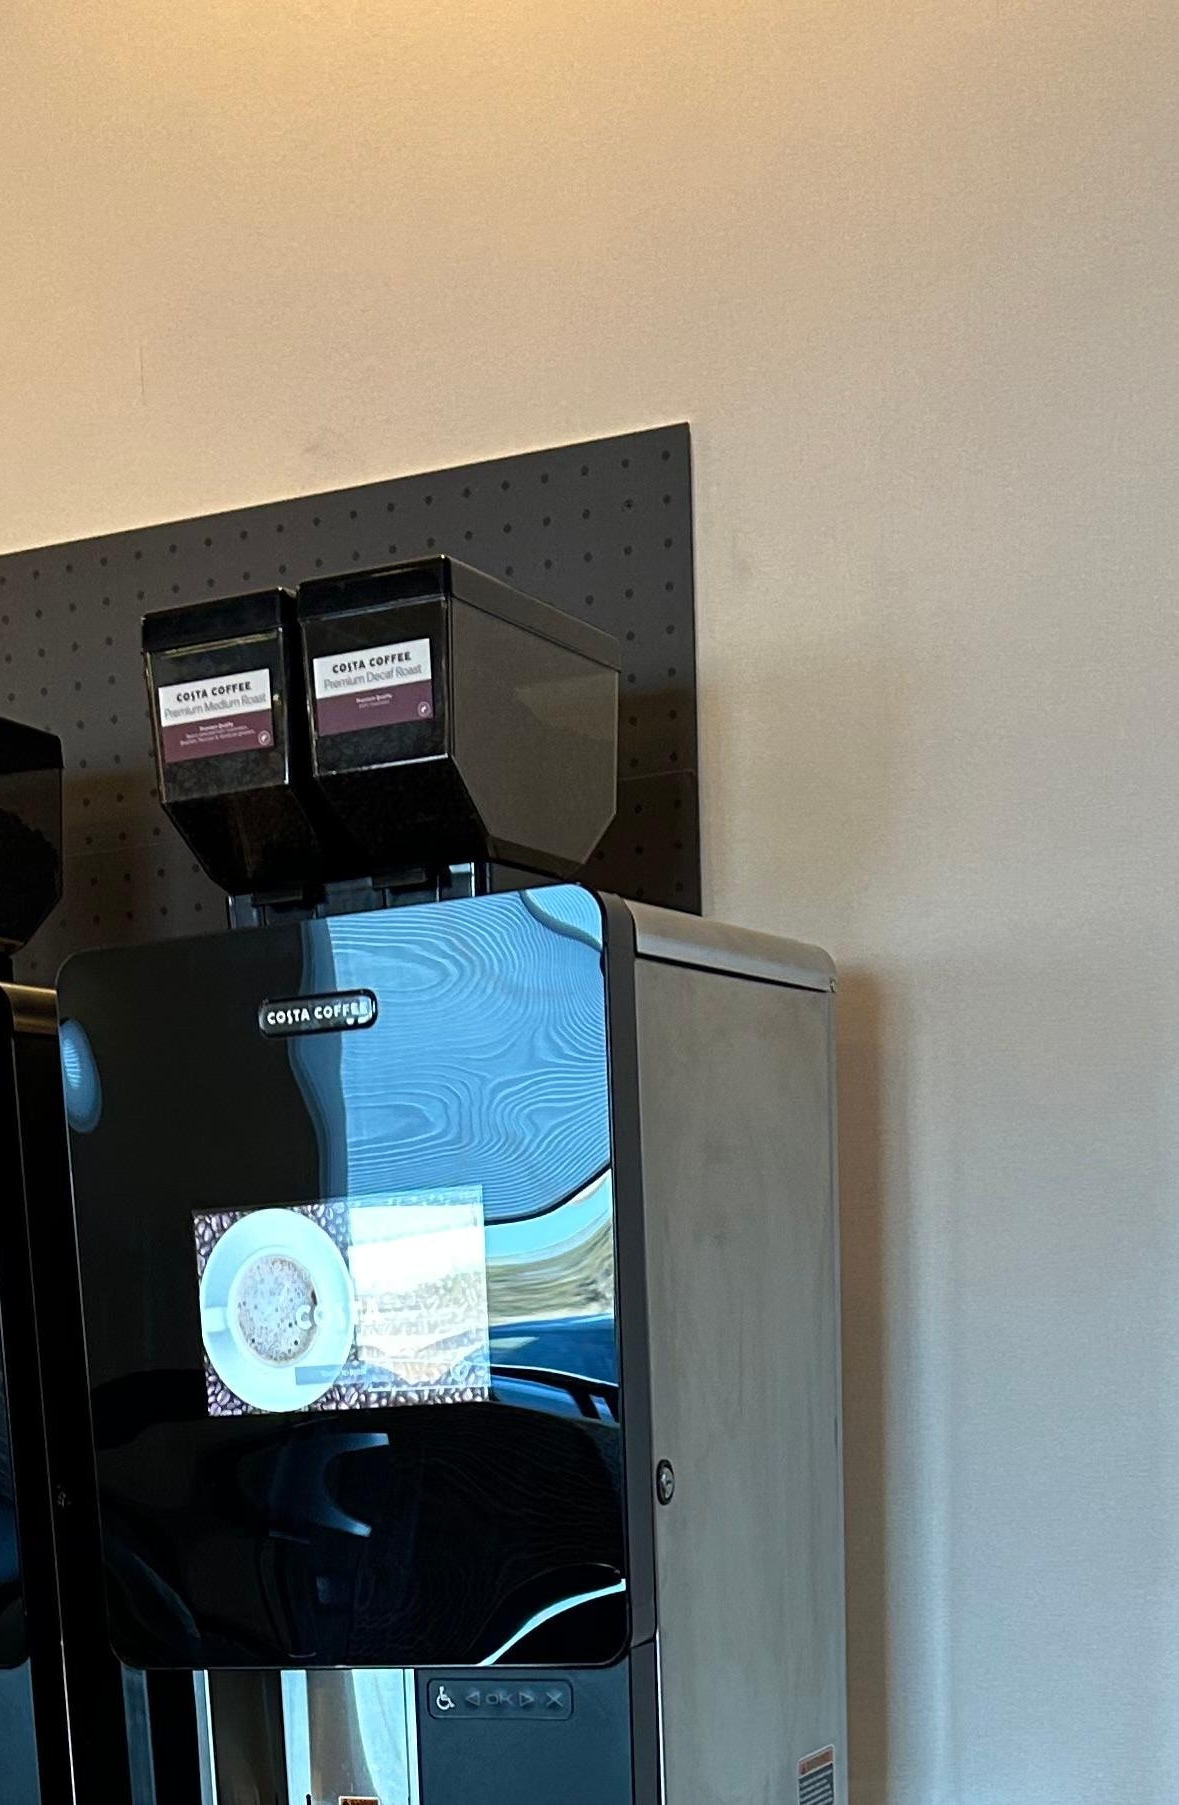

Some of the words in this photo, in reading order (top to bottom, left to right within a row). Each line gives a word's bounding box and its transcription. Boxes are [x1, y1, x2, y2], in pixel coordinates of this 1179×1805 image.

[332, 659, 366, 674] COSTA
[369, 651, 412, 668] COFFEE
[323, 675, 366, 690] Premium
[366, 668, 395, 683] Decaf
[395, 664, 422, 678] Roast
[176, 689, 208, 703] COSTA
[211, 681, 252, 696] COFFEE
[164, 705, 203, 720] Premium
[204, 698, 241, 712] Medium
[241, 692, 267, 706] Roast
[266, 1007, 311, 1025] COSTA
